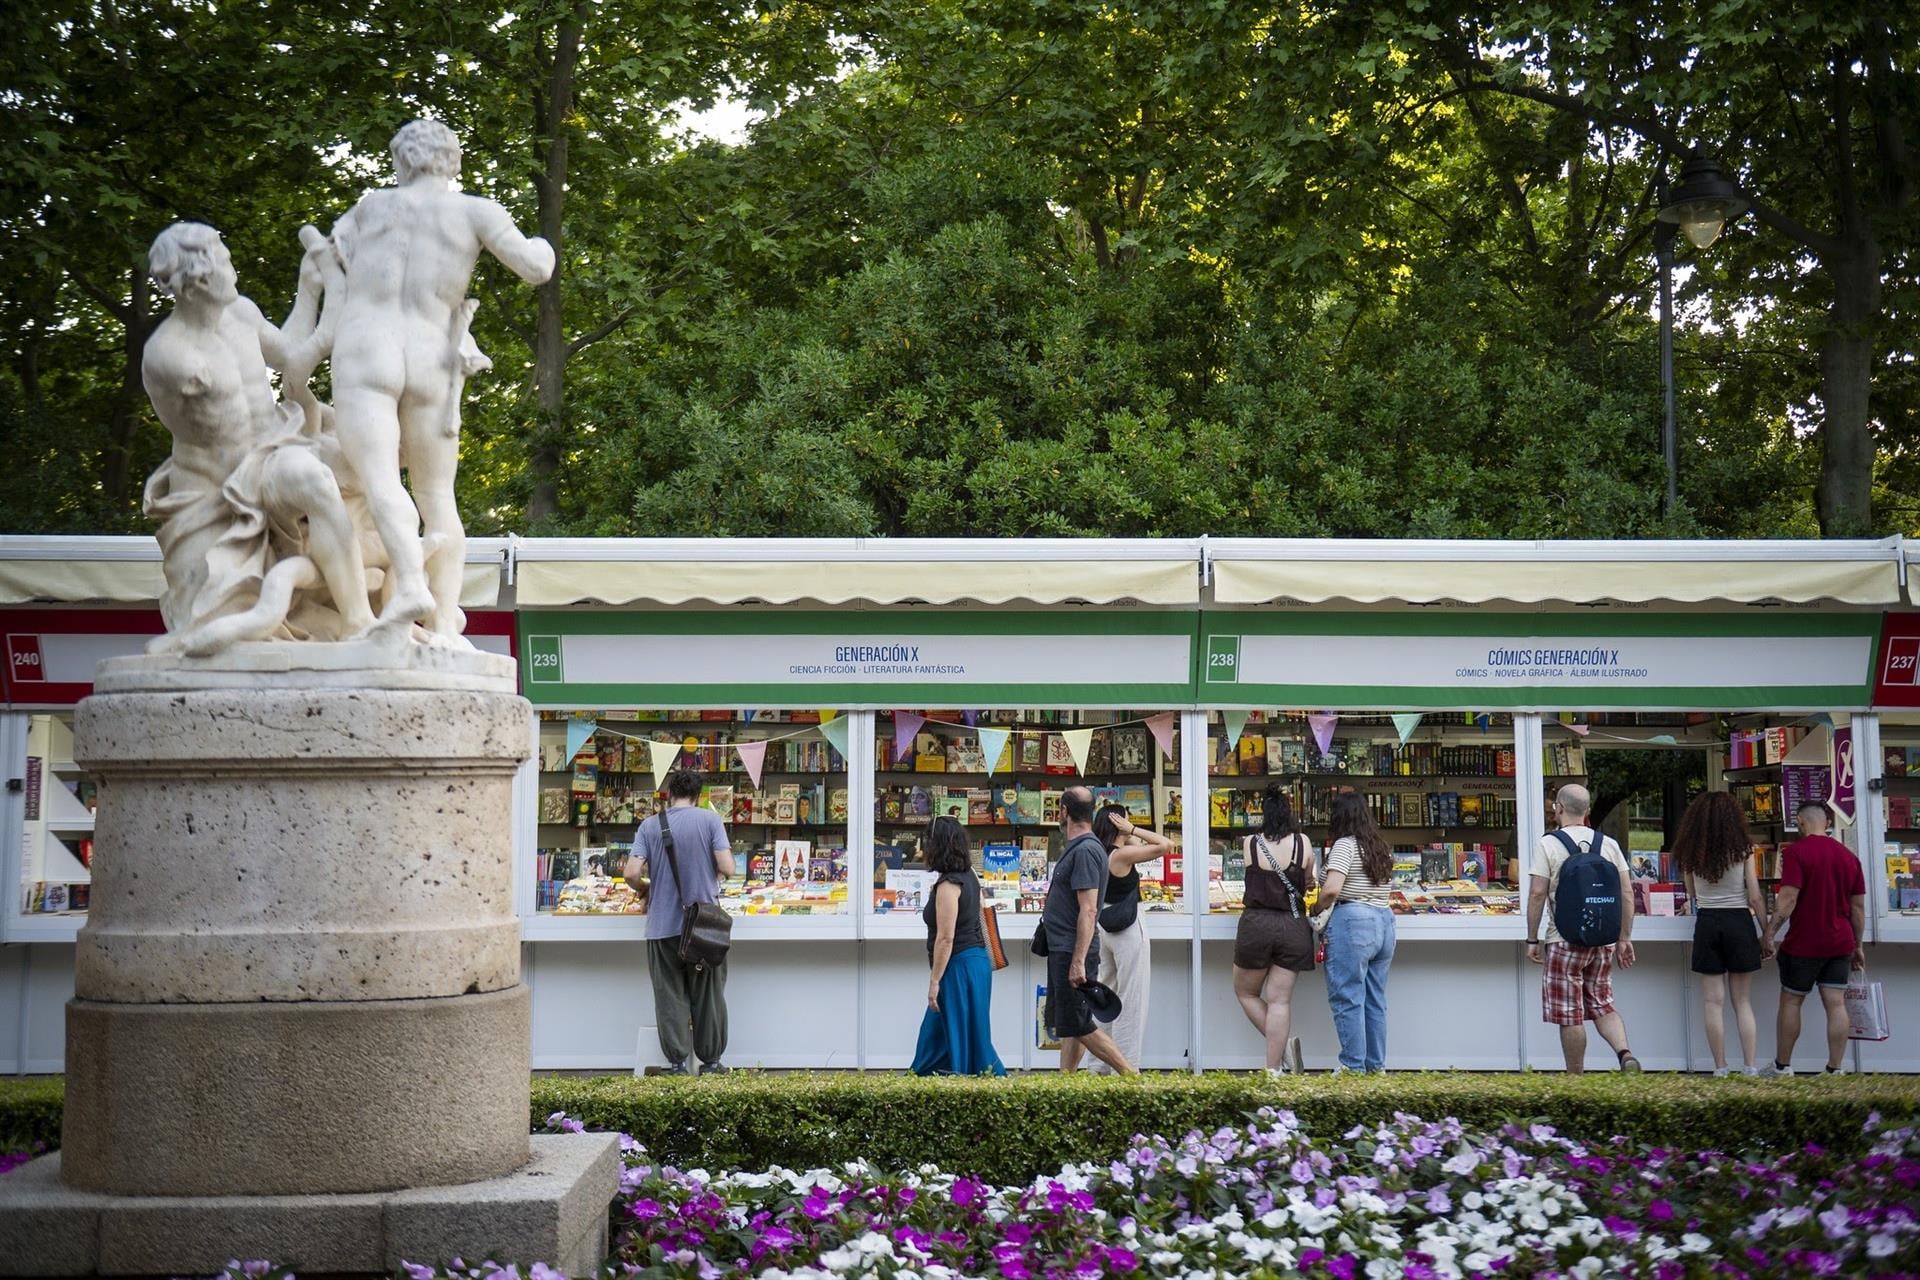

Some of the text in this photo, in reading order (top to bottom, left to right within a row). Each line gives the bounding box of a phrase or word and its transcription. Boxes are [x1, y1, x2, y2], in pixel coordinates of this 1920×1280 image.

[13, 652, 40, 666] 240
[533, 653, 558, 667] 239
[835, 643, 919, 663] GENERACIÓN X
[1210, 653, 1235, 667] 238
[1487, 647, 1619, 666] CÓMICS GENERACIÓN X
[789, 663, 965, 674] CIENCIA FICCIÓN LITERATURA FANTÁSTICA
[1890, 655, 1916, 669] 237
[1455, 667, 1648, 678] CÓMICS NOVELA GRÁFICA ÁLBUM ILUSTRADO
